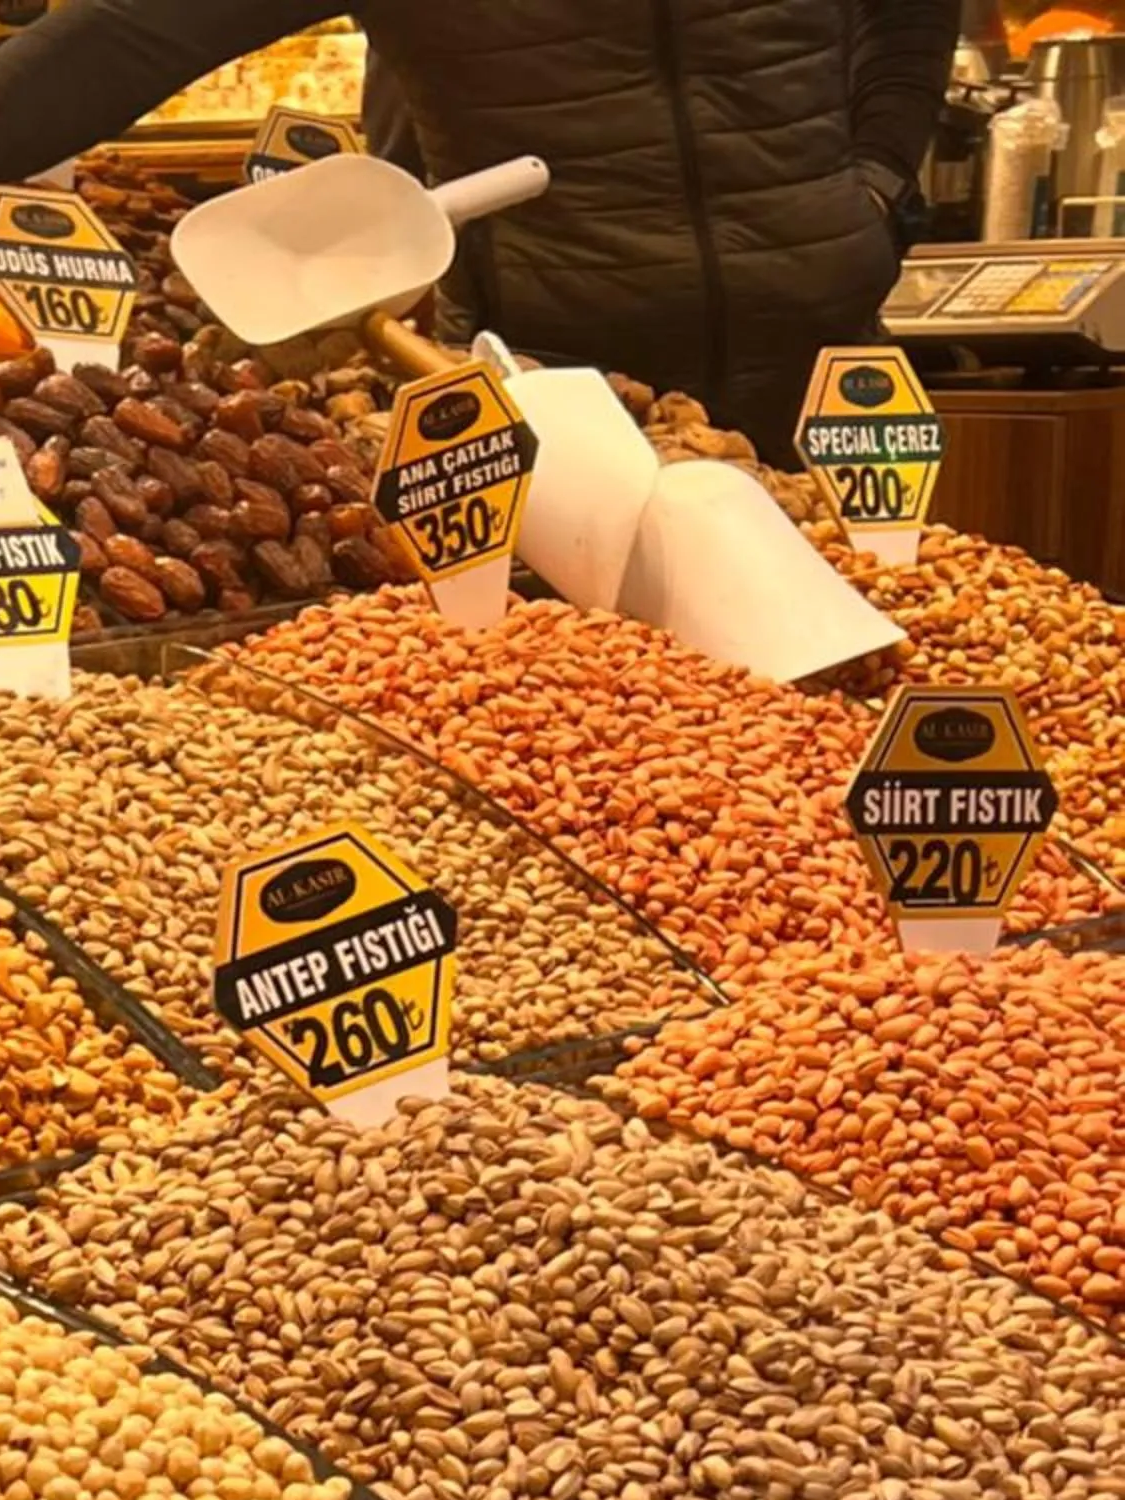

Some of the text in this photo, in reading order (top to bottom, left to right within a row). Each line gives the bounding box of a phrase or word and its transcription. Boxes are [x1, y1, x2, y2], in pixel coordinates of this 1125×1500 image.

[52, 254, 135, 285] HURMA
[398, 429, 515, 489] ANA ÇATLAK
[862, 779, 1044, 825] SİİRT FISTIK
[235, 905, 446, 1021] ANTEP FISTIĞI
